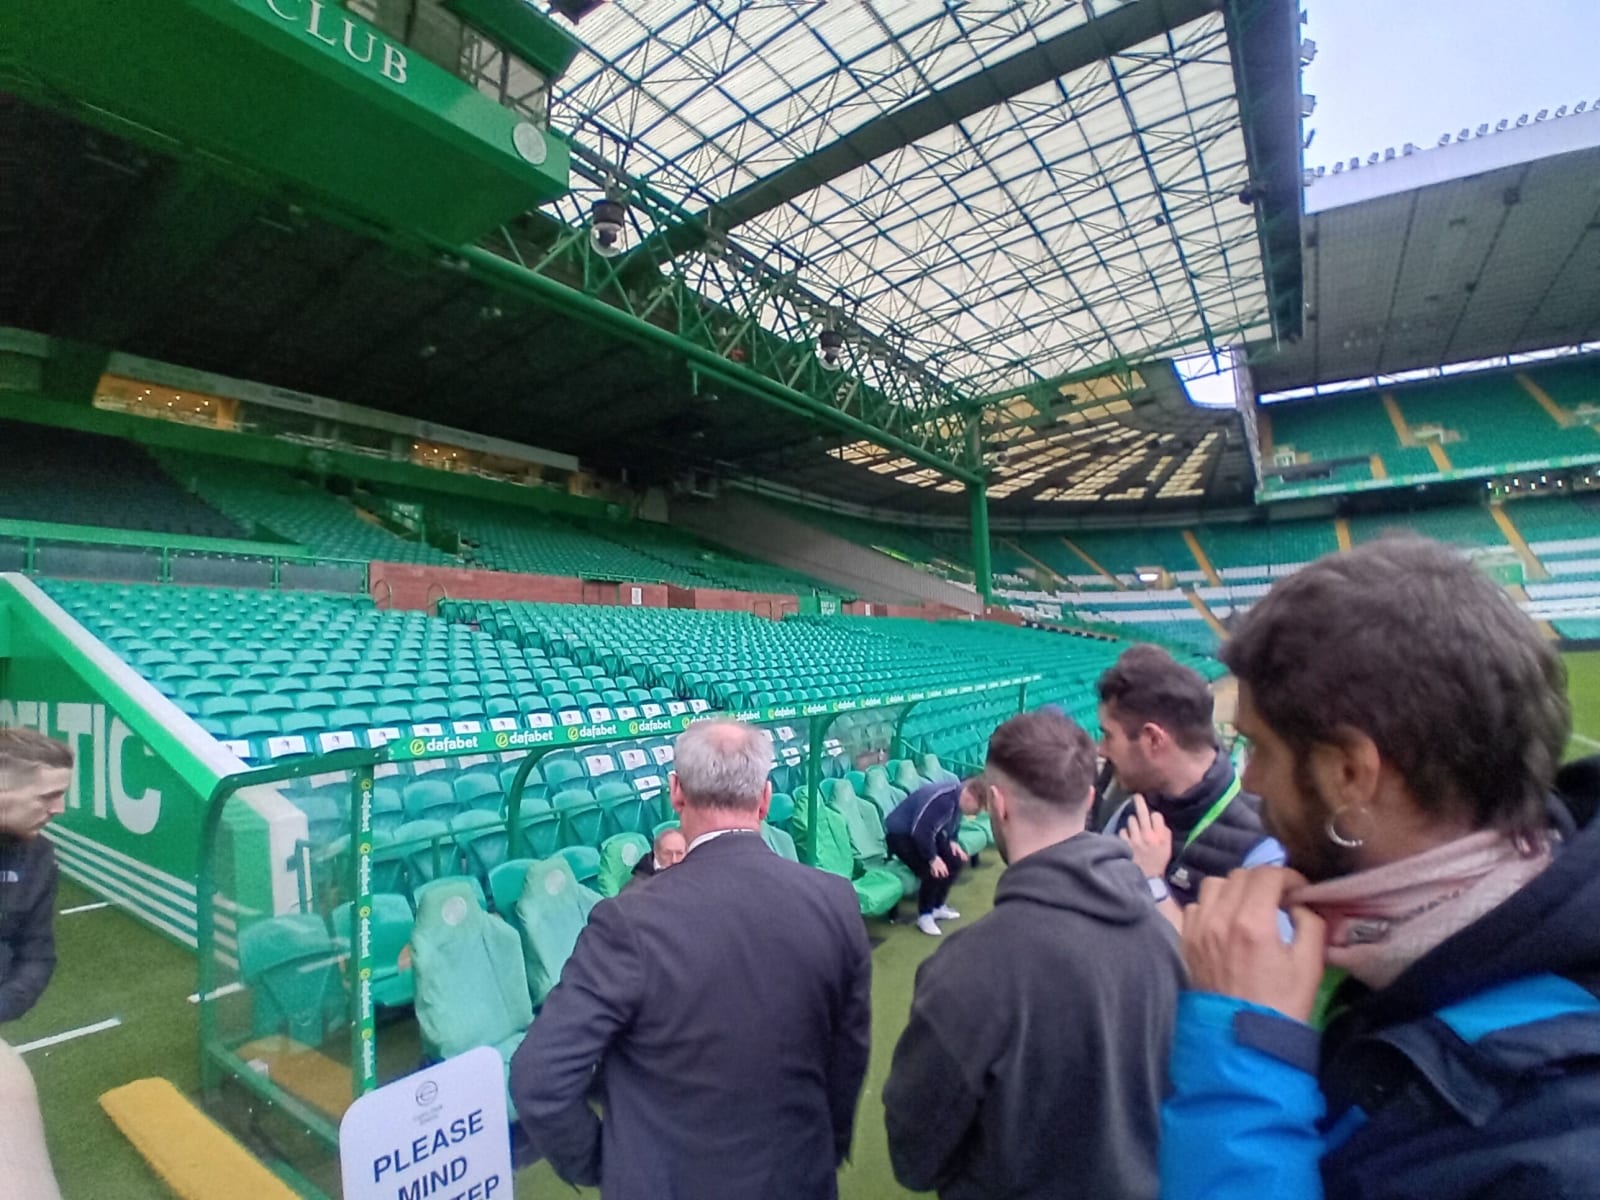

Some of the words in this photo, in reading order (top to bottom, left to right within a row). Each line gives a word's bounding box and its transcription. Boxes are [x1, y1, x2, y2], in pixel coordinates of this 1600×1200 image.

[426, 736, 478, 753] dafabet
[509, 730, 553, 747] dafabet
[579, 724, 617, 739] dafabet
[639, 719, 672, 733] dafabet
[373, 1108, 484, 1183] PLEASE
[398, 1156, 468, 1200] MIND
